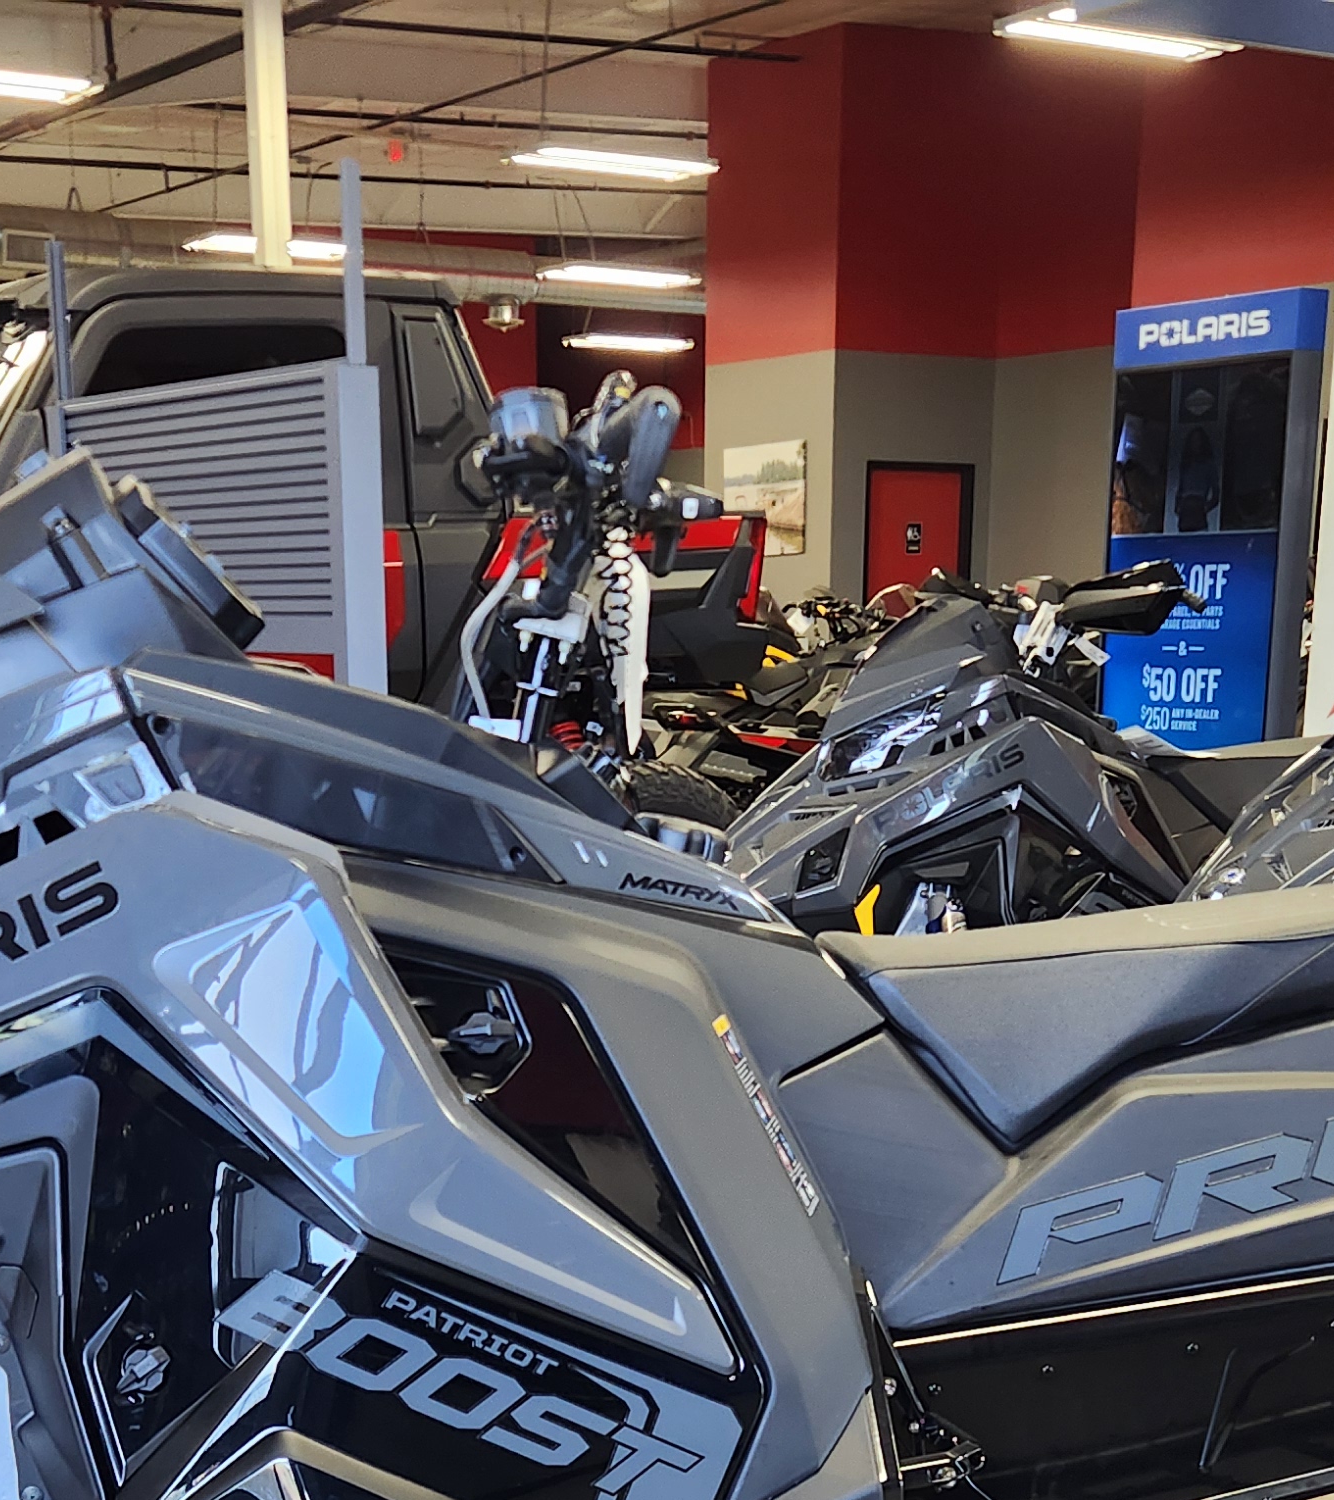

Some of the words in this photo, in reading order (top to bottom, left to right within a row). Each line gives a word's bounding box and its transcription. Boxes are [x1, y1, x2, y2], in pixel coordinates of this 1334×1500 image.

[1138, 309, 1271, 351] POLARIS
[1189, 563, 1231, 600] OFF
[1142, 663, 1177, 702] $50
[1181, 667, 1222, 703] OFF
[1141, 704, 1169, 731] $250
[1171, 708, 1184, 719] ANY
[1171, 720, 1197, 731] SERVICE
[618, 872, 740, 912] MATRYX
[386, 1290, 561, 1377] PATRIOT
[213, 1269, 705, 1495] BOOST
